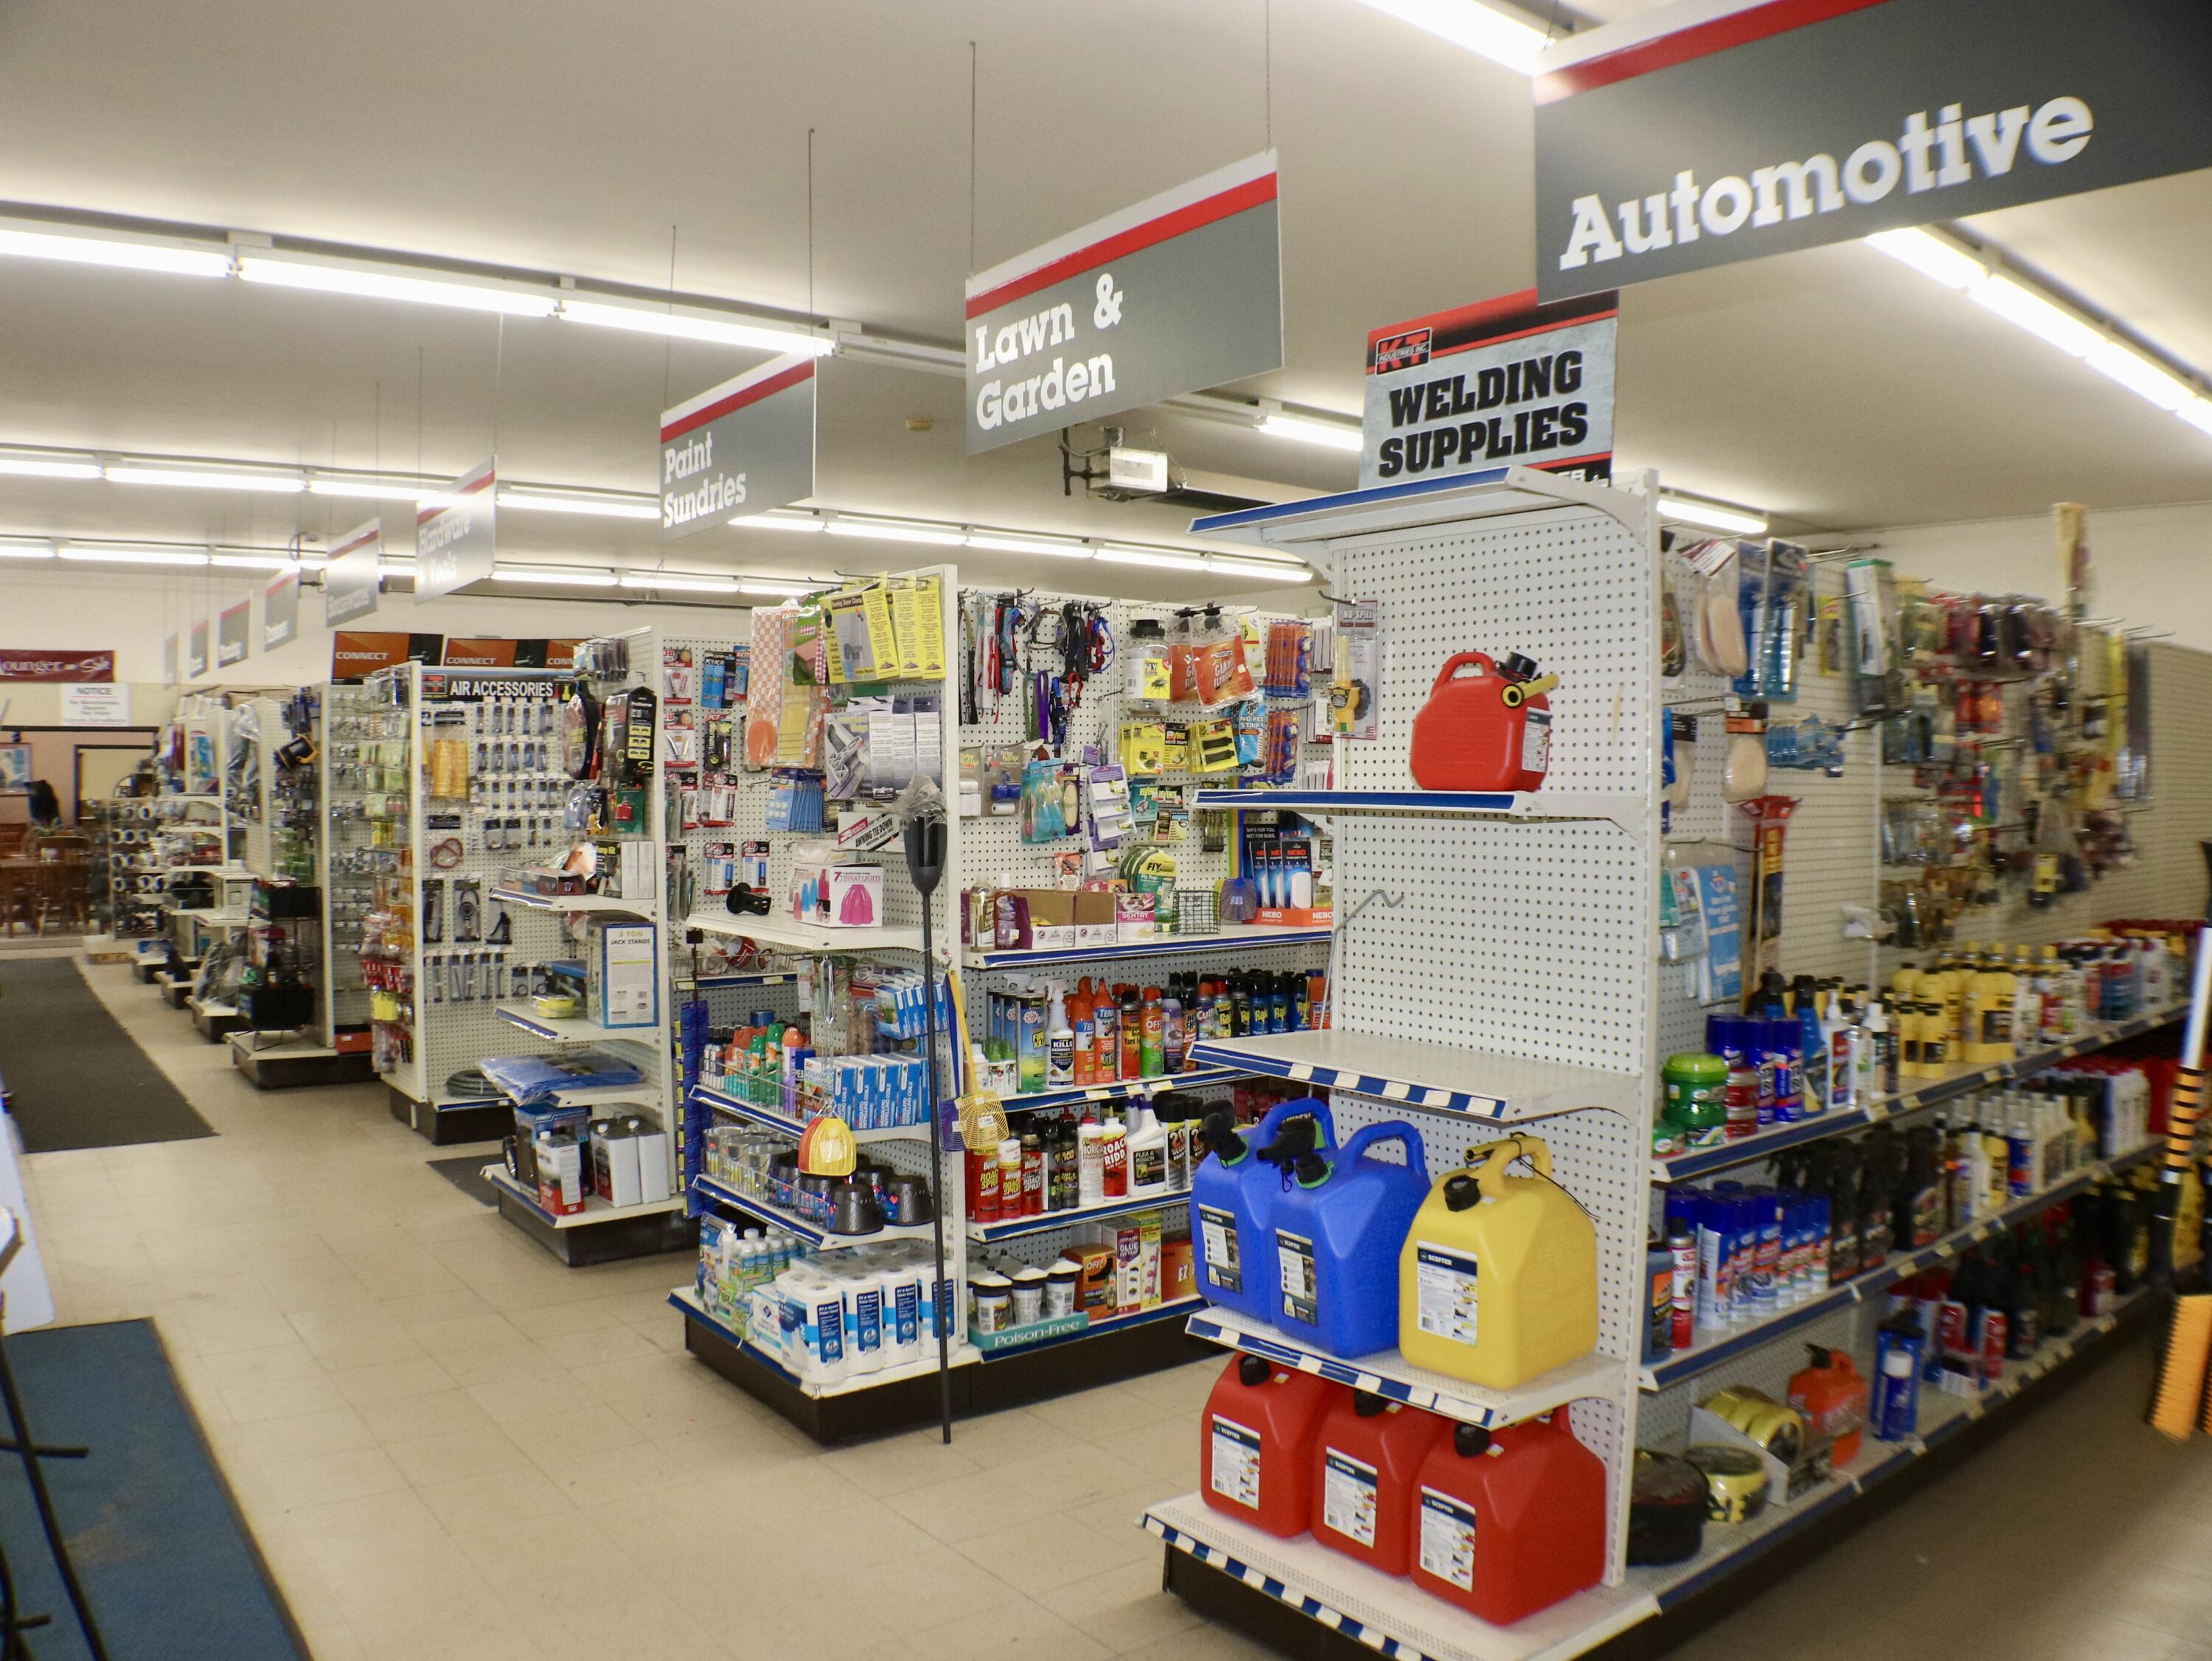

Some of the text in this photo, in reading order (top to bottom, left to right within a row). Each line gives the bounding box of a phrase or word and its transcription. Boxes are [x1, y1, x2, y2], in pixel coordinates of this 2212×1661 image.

[1559, 97, 2093, 271] Automotive
[975, 273, 1123, 374] Lawn &
[1378, 331, 1429, 372] KT
[975, 353, 1116, 431] Garden
[1389, 350, 1583, 428] WELDING
[1378, 402, 1589, 478] SUPPLIES
[664, 431, 713, 484] Paint
[664, 472, 747, 529] Sundries
[418, 512, 471, 558] Hardware
[431, 550, 458, 584] Tools
[1343, 609, 1374, 620] NO-SPILL
[335, 652, 389, 661] CONNECT
[445, 657, 496, 665] CONNECT
[77, 687, 112, 695] NOTICE
[451, 680, 554, 697] AIR ACCESSORIES
[855, 829, 873, 847] AWNING
[879, 817, 893, 832] DOWN
[1147, 862, 1162, 871] FLY
[834, 871, 842, 882] 7
[1135, 1155, 1155, 1163] ROACH
[1207, 1213, 1222, 1223] SCEPTER
[1120, 1242, 1138, 1252] GLUE
[1284, 1239, 1301, 1250] SCEPTER
[1086, 1259, 1104, 1270] OFF!
[1427, 1254, 1453, 1267] SCEPTER
[995, 1320, 1080, 1347] Poison-Free
[1221, 1427, 1240, 1440] SCEPTER
[1335, 1460, 1355, 1474] SCEPTER
[1431, 1500, 1454, 1514] SCEPTER
